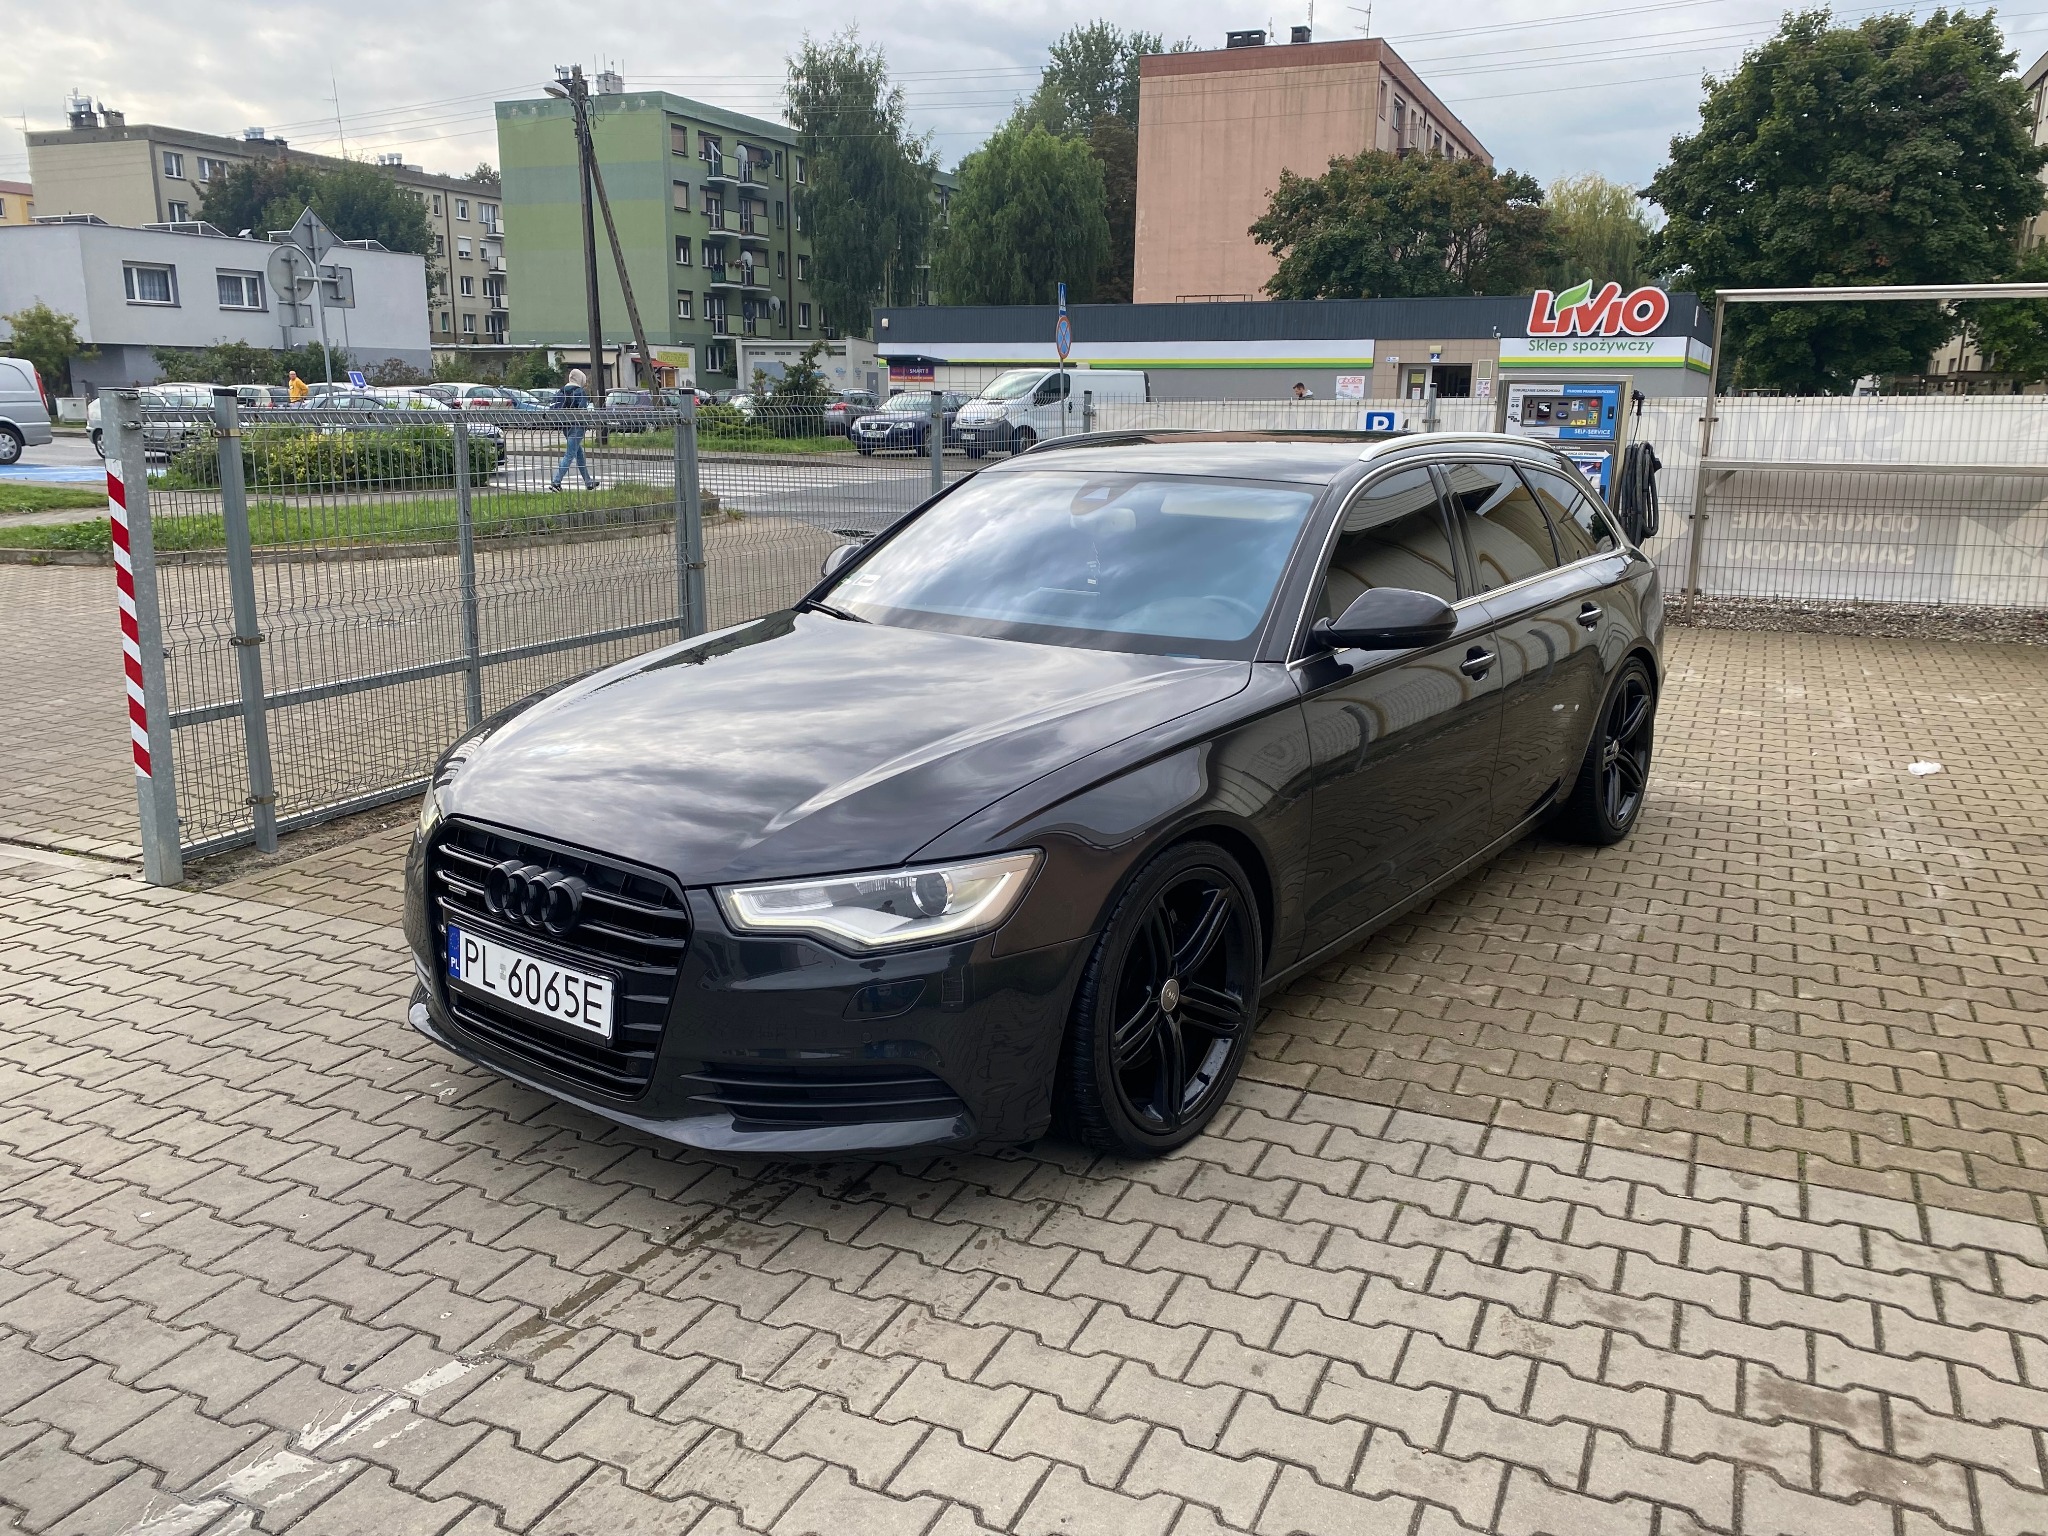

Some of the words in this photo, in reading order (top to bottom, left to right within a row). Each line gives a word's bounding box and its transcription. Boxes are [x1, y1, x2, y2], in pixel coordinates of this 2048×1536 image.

[1528, 339, 1568, 353] Sklep
[1572, 338, 1655, 354] spożywczy
[353, 374, 363, 385] L
[1373, 415, 1390, 430] P
[450, 956, 460, 971] PL
[465, 937, 496, 990] PL
[508, 958, 603, 1029] 6065E
